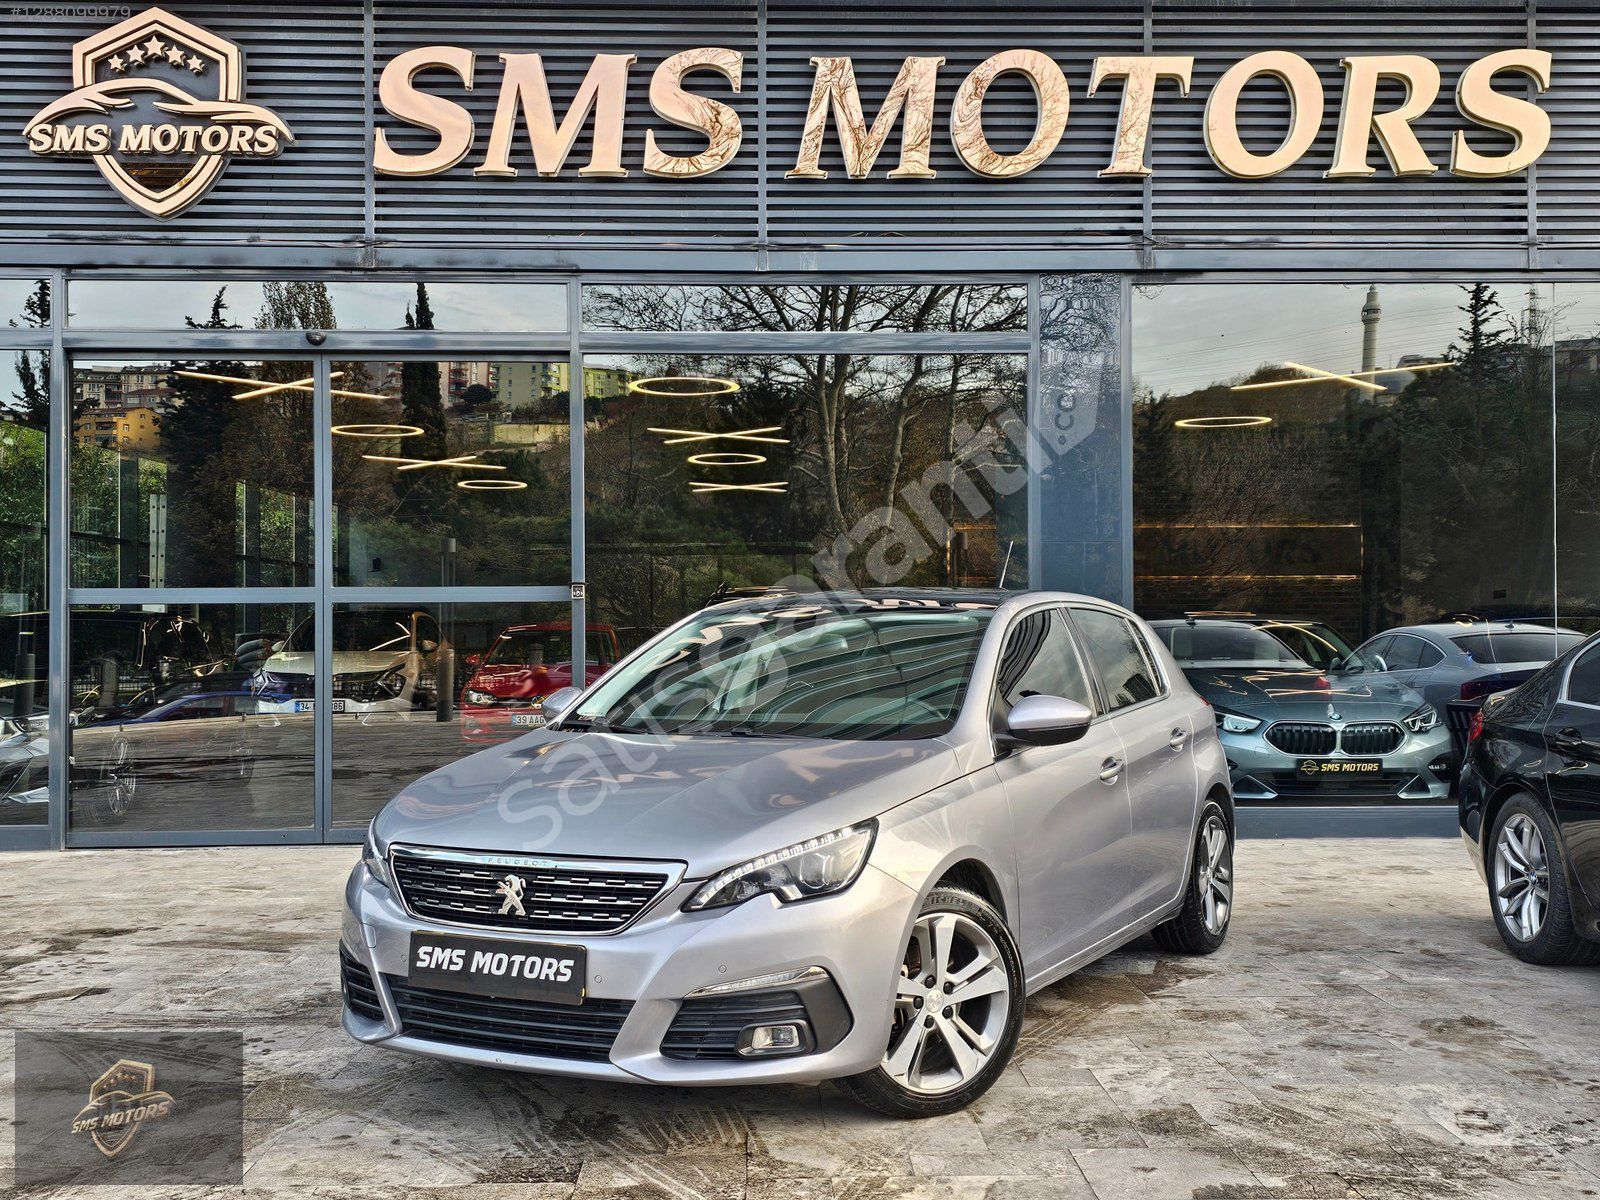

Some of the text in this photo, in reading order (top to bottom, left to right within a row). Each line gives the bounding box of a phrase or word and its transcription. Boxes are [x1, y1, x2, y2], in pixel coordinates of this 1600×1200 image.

[374, 46, 1554, 180] SMS MOTORS
[28, 123, 280, 155] SMS MOTORS
[301, 703, 309, 711] 34
[517, 715, 545, 724] 39 AAG
[1320, 763, 1340, 772] SMS
[1341, 763, 1379, 772] MOTORS
[488, 857, 547, 868] PEUGEOT
[416, 945, 575, 982] SMS MOTORS
